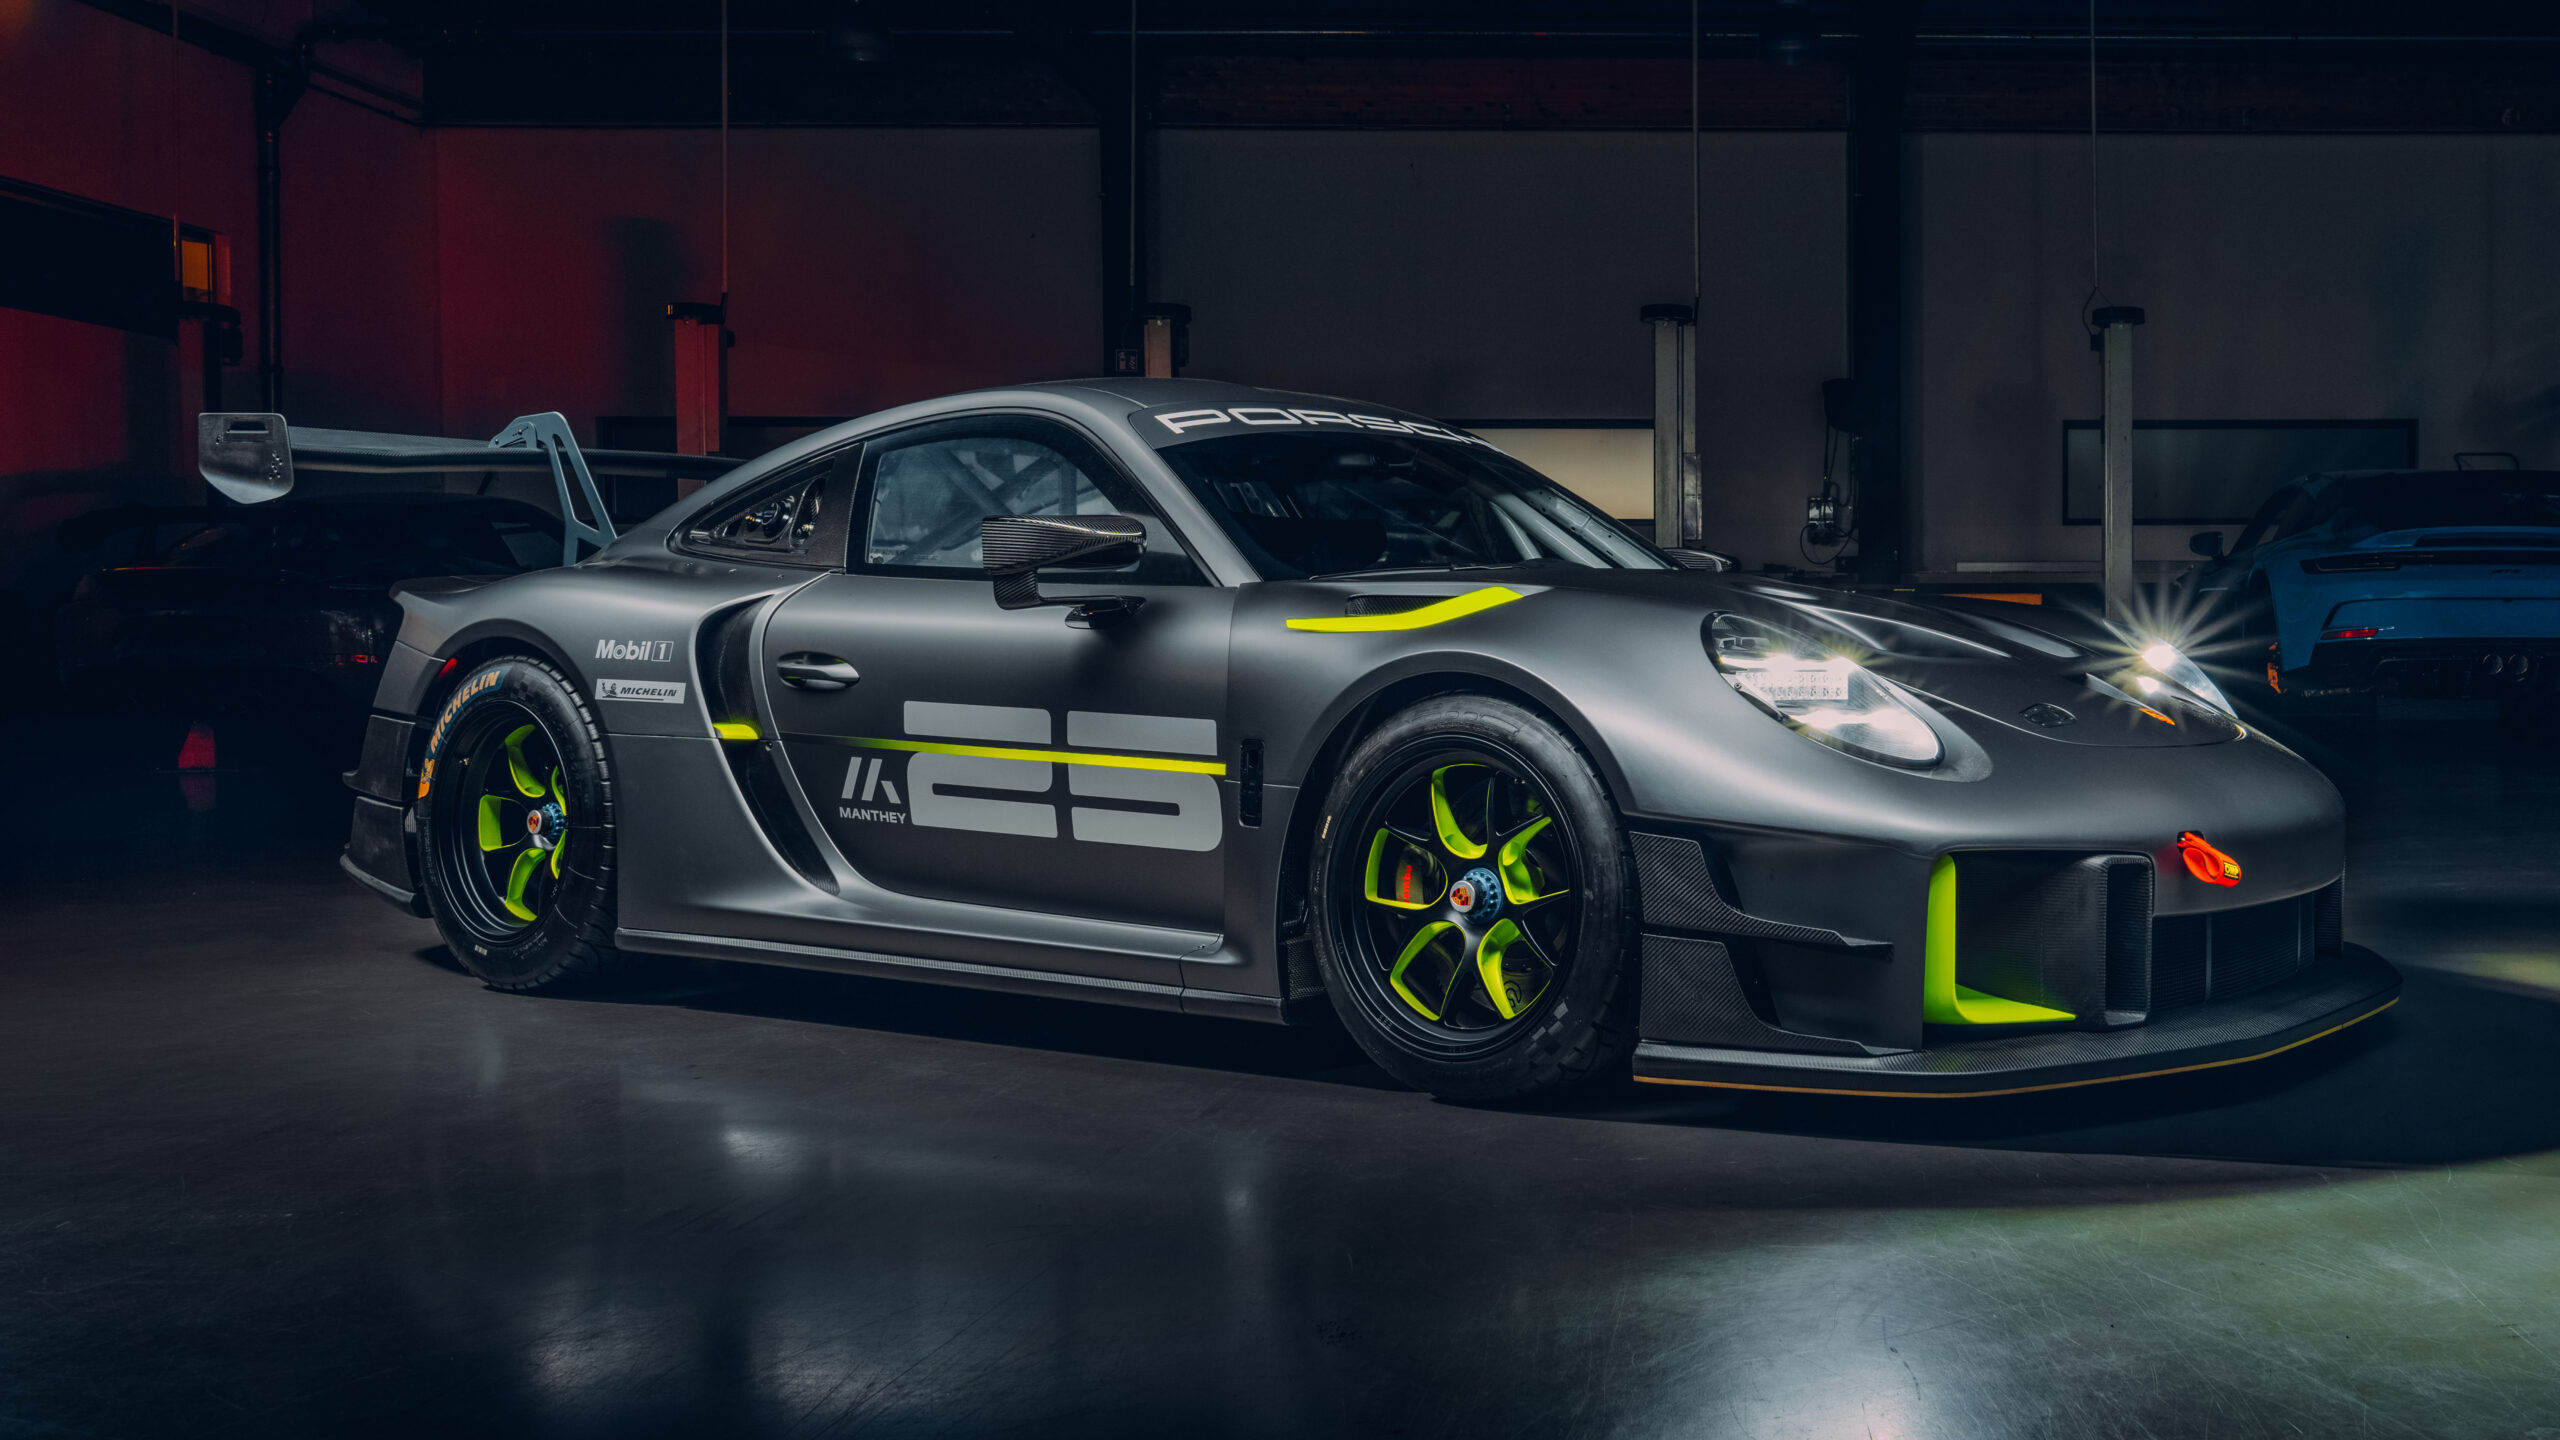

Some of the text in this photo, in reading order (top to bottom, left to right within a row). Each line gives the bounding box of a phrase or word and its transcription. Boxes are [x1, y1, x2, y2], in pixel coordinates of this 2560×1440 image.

[595, 640, 651, 660] Mobil
[620, 686, 677, 697] MICHELIN
[430, 669, 500, 753] MICHELIN
[903, 700, 1223, 852] 25
[839, 806, 906, 824] MANTHEY
